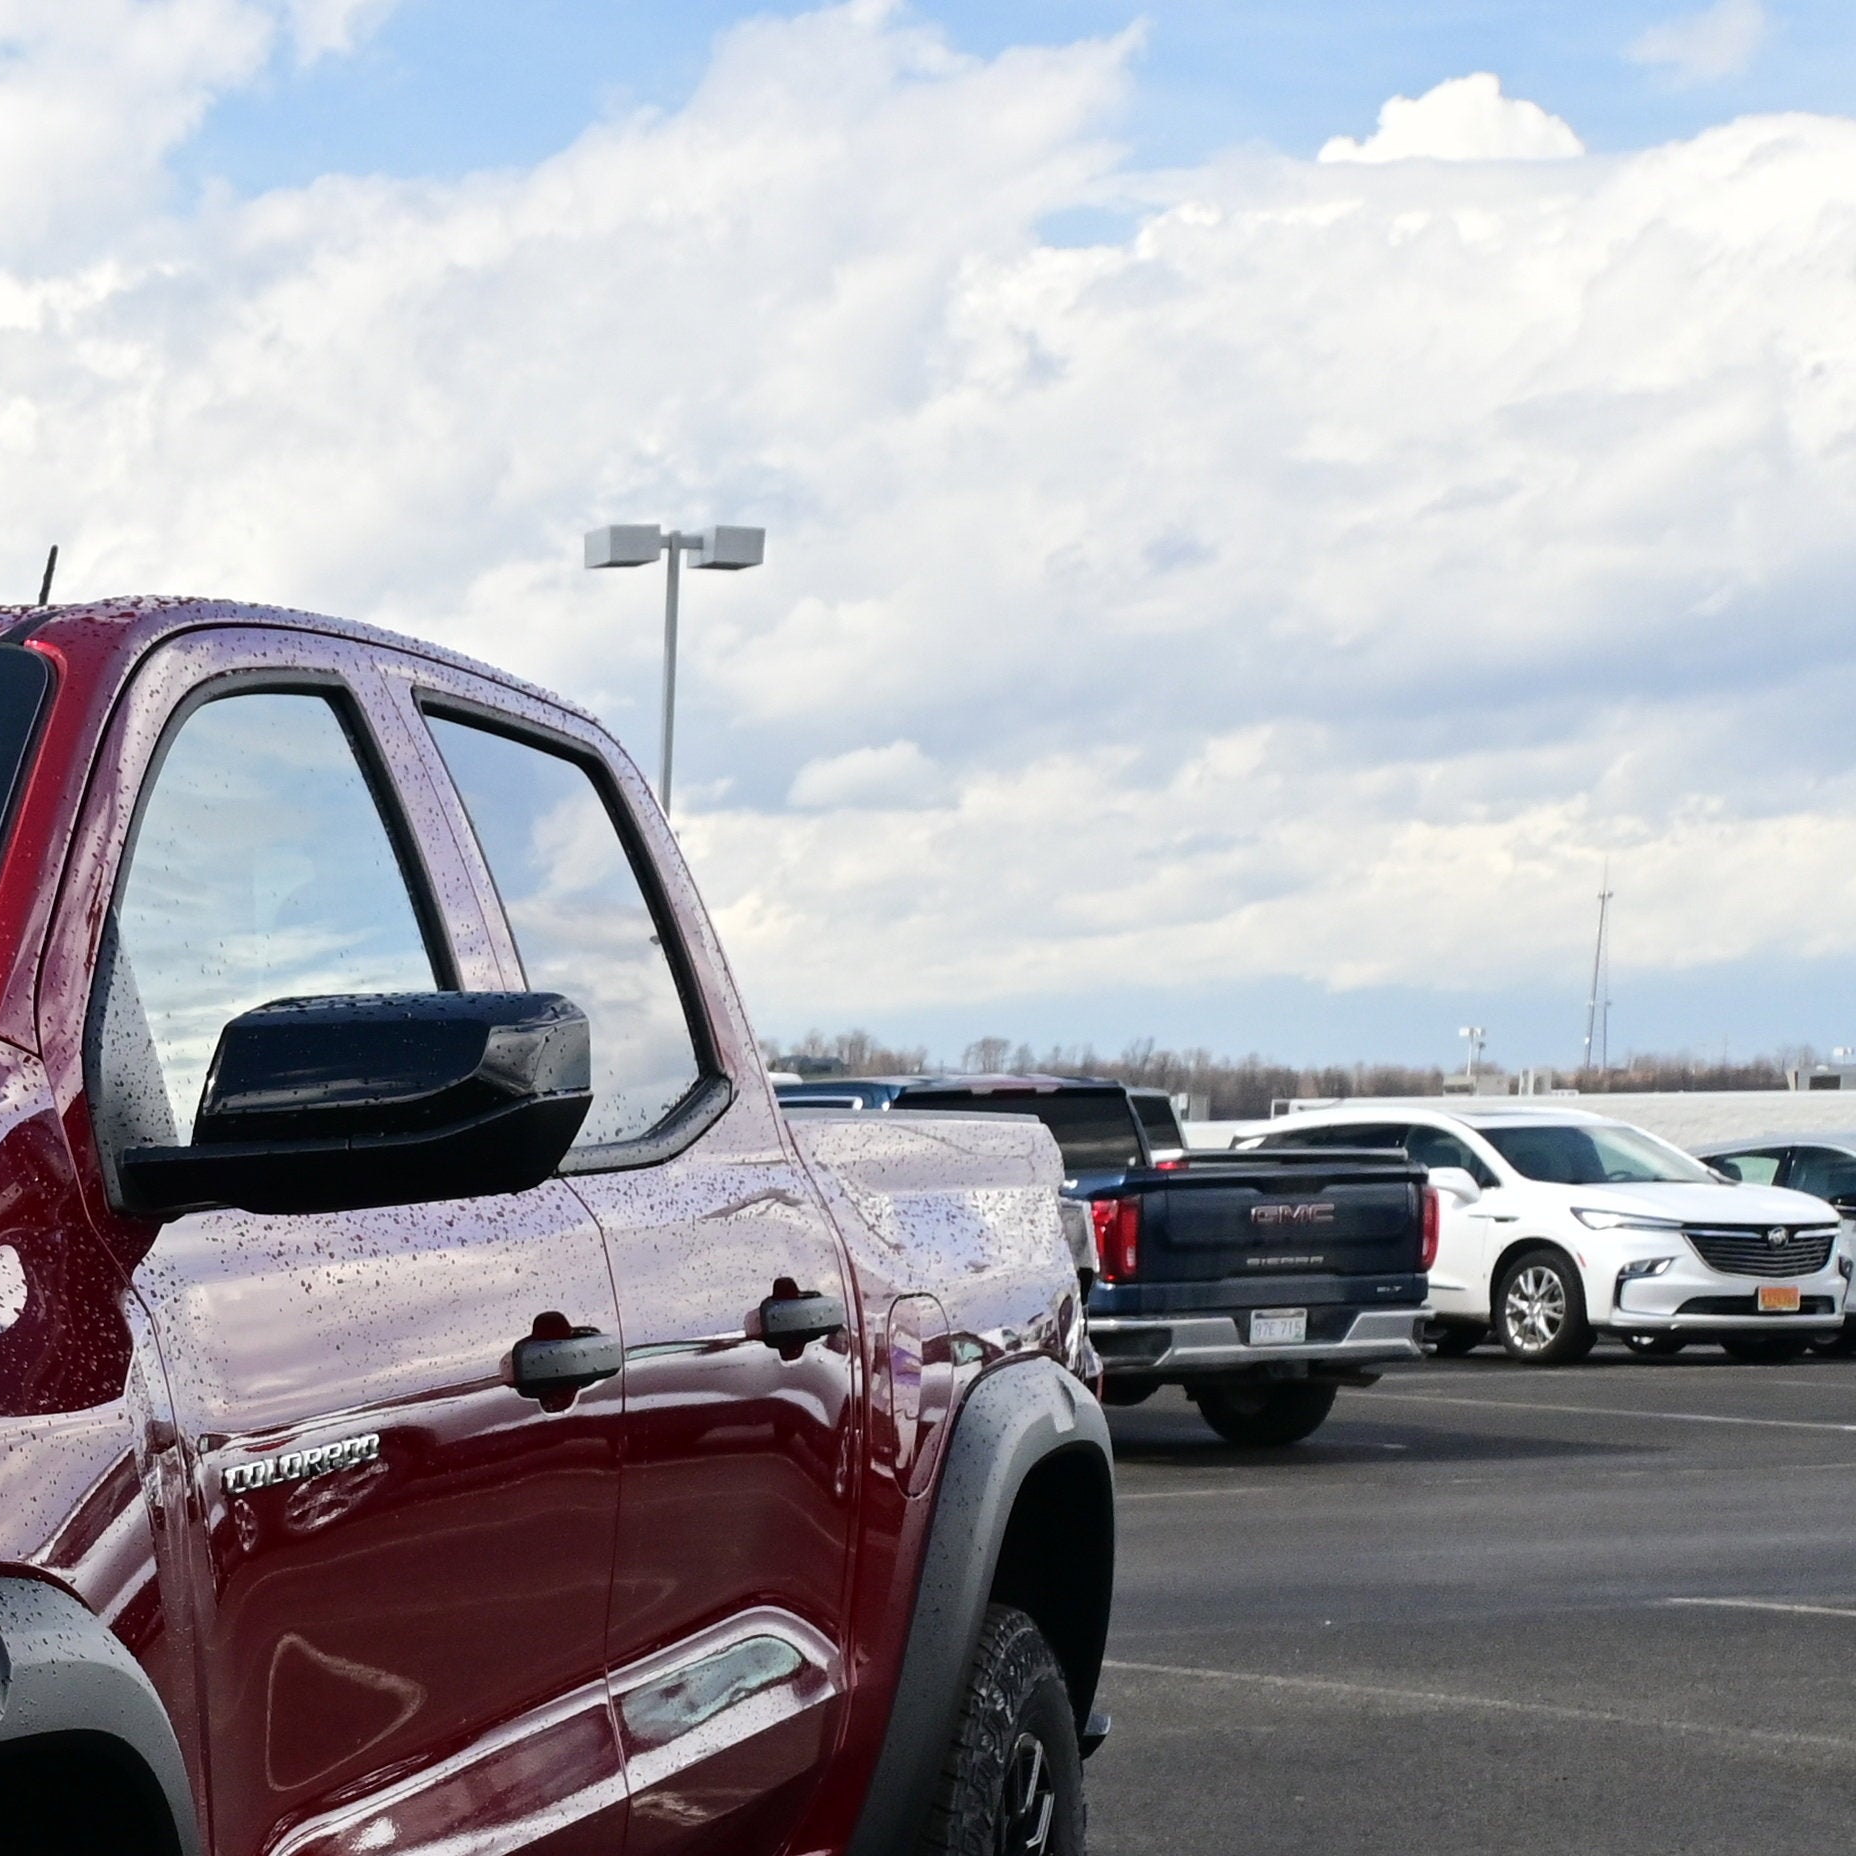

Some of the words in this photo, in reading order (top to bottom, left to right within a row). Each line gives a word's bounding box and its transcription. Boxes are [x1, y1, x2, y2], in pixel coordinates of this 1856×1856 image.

[1251, 1203, 1335, 1223] GMC
[1246, 1256, 1324, 1266] SIERRA
[222, 1433, 381, 1494] COLORADO
